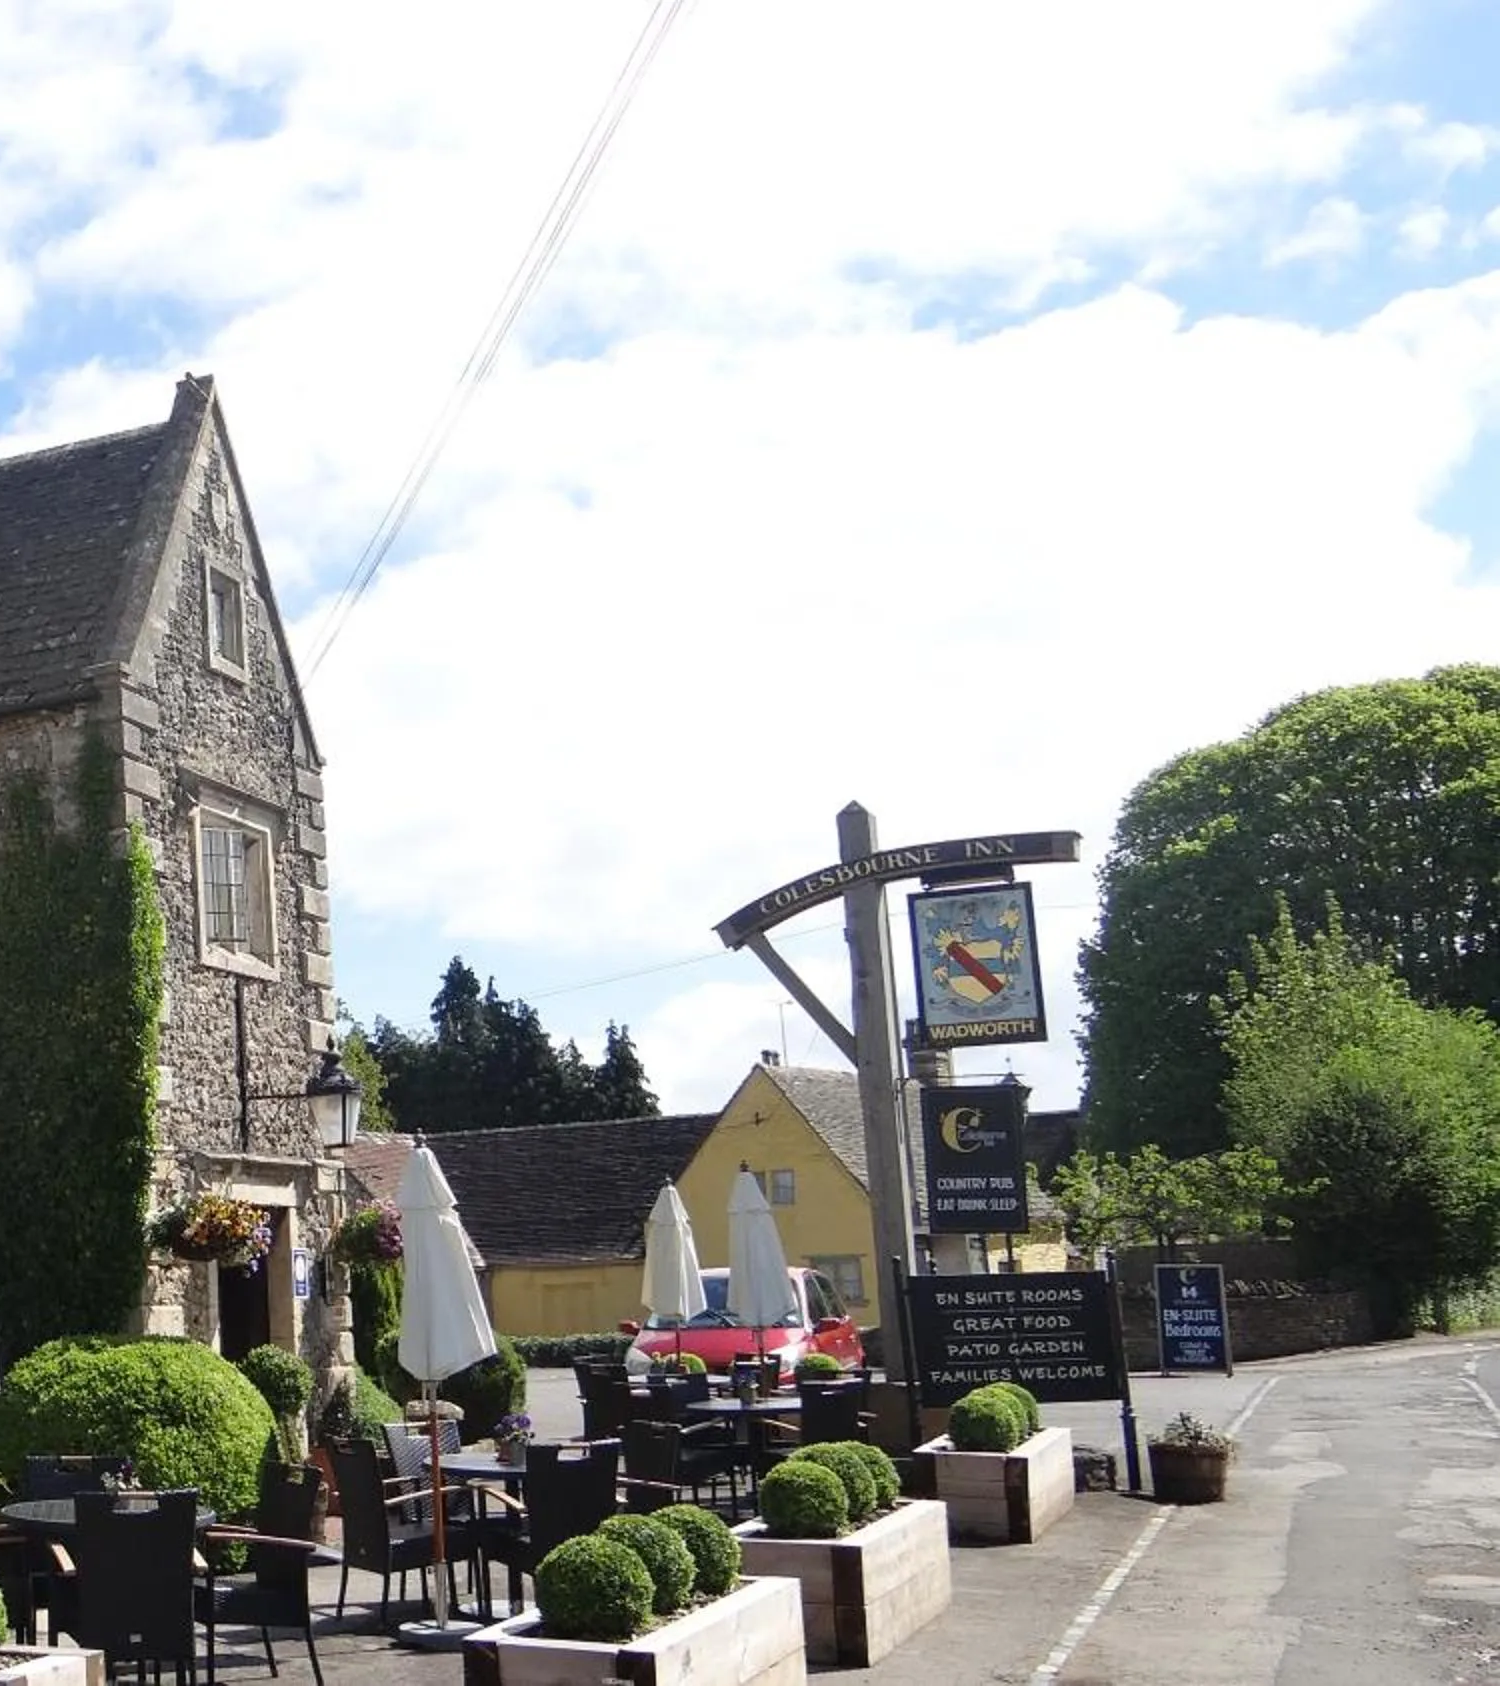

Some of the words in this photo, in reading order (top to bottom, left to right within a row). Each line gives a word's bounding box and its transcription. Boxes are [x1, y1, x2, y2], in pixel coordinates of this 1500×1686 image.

[760, 846, 941, 914] COLESBOURNE
[964, 838, 1016, 859] INN
[930, 1019, 1036, 1040] WADWORTH
[936, 1177, 987, 1191] COUNTRY
[989, 1177, 1015, 1190] PUB
[935, 1292, 959, 1306] EN
[964, 1290, 1016, 1306] SUITE
[1021, 1289, 1084, 1304] ROOMS
[952, 1316, 1016, 1334] GREAT
[1023, 1314, 1072, 1330] FOOD
[1164, 1323, 1222, 1337] Bedrooms
[947, 1342, 1001, 1357] PATIO
[1009, 1340, 1084, 1355] GARDEN
[929, 1367, 1013, 1384] FAMILIES
[1019, 1365, 1107, 1381] WELCOME
